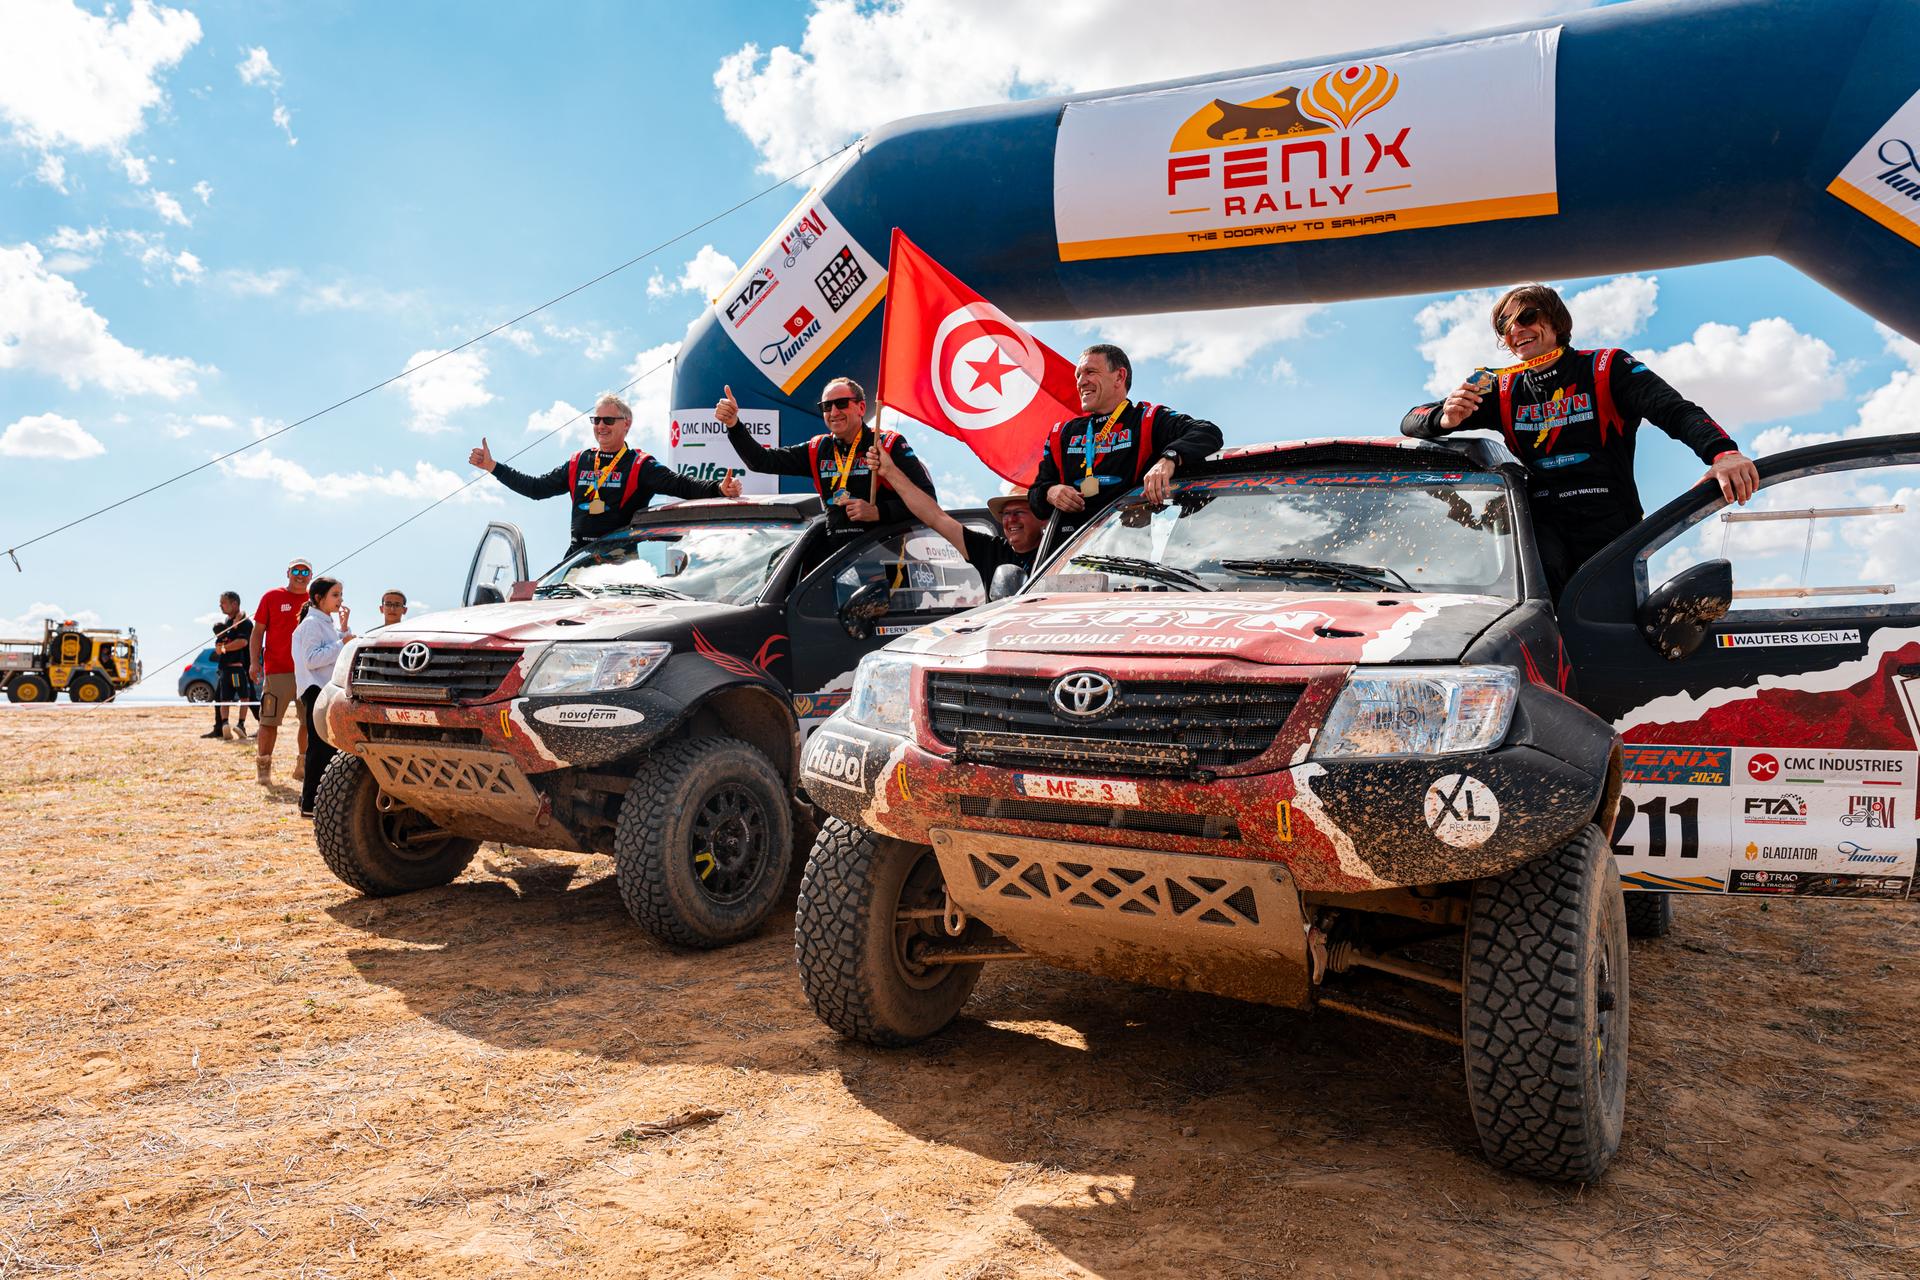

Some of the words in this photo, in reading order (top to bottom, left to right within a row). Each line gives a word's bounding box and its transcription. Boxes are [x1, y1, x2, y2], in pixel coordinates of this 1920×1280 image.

[1167, 127, 1412, 195] FENIX
[1224, 183, 1353, 216] RALLY
[1187, 232, 1218, 242] THE
[1222, 223, 1297, 239] DOORWAY
[1303, 220, 1325, 230] TO
[1331, 212, 1397, 228] SAHARA
[725, 276, 769, 321] FTA
[830, 270, 865, 309] SPORT
[759, 318, 822, 366] Tunisia
[1516, 393, 1591, 421] FERYN
[681, 422, 700, 434] CMC
[702, 423, 771, 435] INDURIES
[1182, 476, 1306, 491] FENIX
[1306, 475, 1409, 484] RALLY
[1559, 490, 1578, 498] KOEN
[1578, 487, 1609, 495] WAUTERS
[885, 626, 908, 634] FERYN
[1734, 634, 1799, 646] WAUTERS
[1802, 632, 1839, 644] KOEN
[1843, 631, 1859, 641] A+
[995, 633, 1126, 645] SECTIONALE
[1131, 634, 1246, 648] POORTEN
[397, 710, 411, 721] MF
[420, 711, 428, 723] 2
[558, 709, 617, 722] novoferm
[807, 738, 862, 783] Hubo
[1622, 749, 1728, 768] FENIX
[1784, 758, 1815, 771] CMC
[1820, 758, 1903, 772] INDUSTRIES
[1624, 769, 1681, 781] ALLY
[1689, 772, 1725, 784] 2026
[1046, 779, 1077, 798] MF
[1101, 784, 1116, 801] 3
[1432, 783, 1490, 828] XL
[1744, 798, 1799, 815] FTA
[1450, 823, 1493, 832] REKLAME
[1612, 795, 1699, 859] 211
[1762, 846, 1818, 860] GLADIATOR
[1837, 841, 1899, 864] Tunisia
